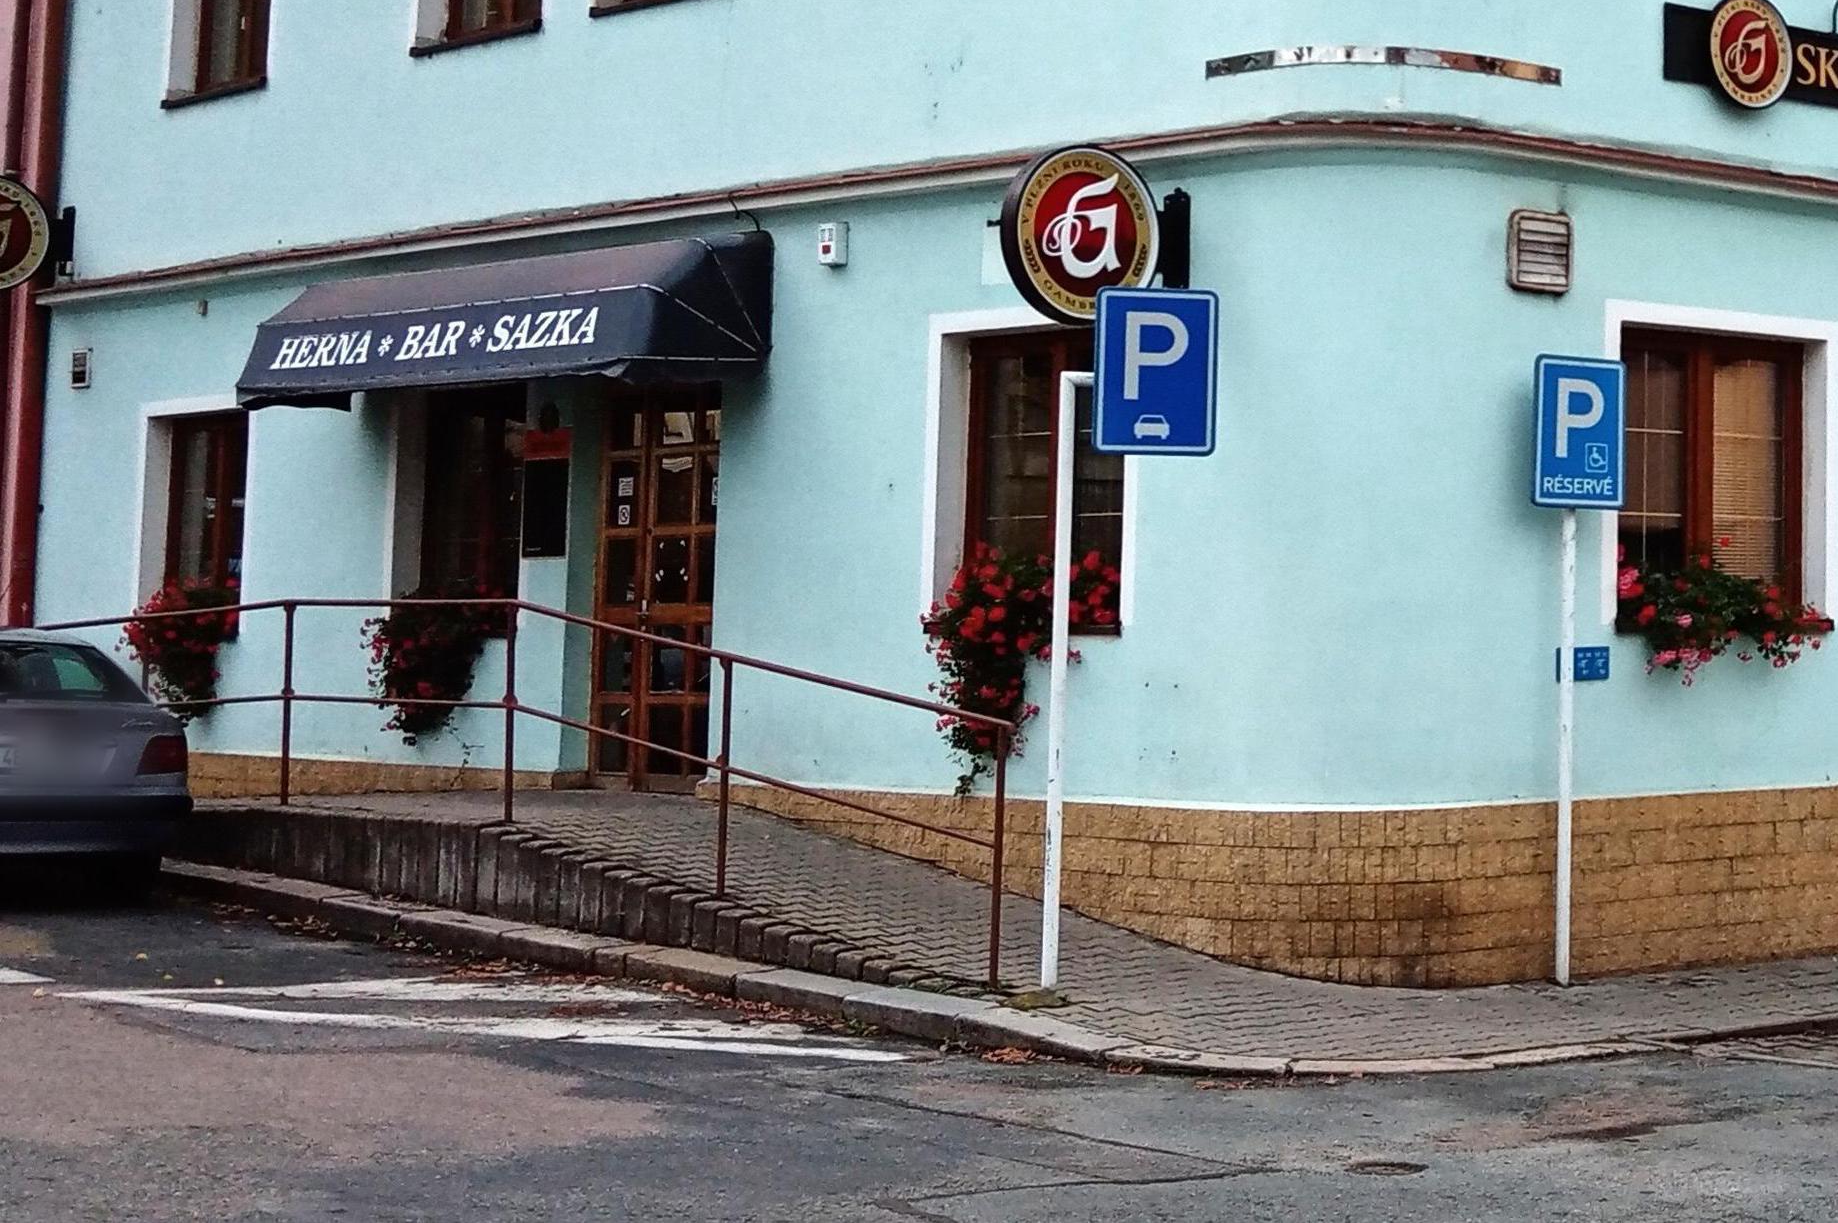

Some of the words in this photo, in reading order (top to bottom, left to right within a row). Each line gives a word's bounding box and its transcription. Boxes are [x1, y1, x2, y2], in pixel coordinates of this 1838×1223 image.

[269, 329, 373, 370] HERNA
[394, 320, 467, 362] BAR
[485, 306, 600, 353] SAZKA
[1123, 311, 1189, 400] P
[1555, 377, 1605, 458] P
[1543, 473, 1614, 496] RÉSERVÉ
